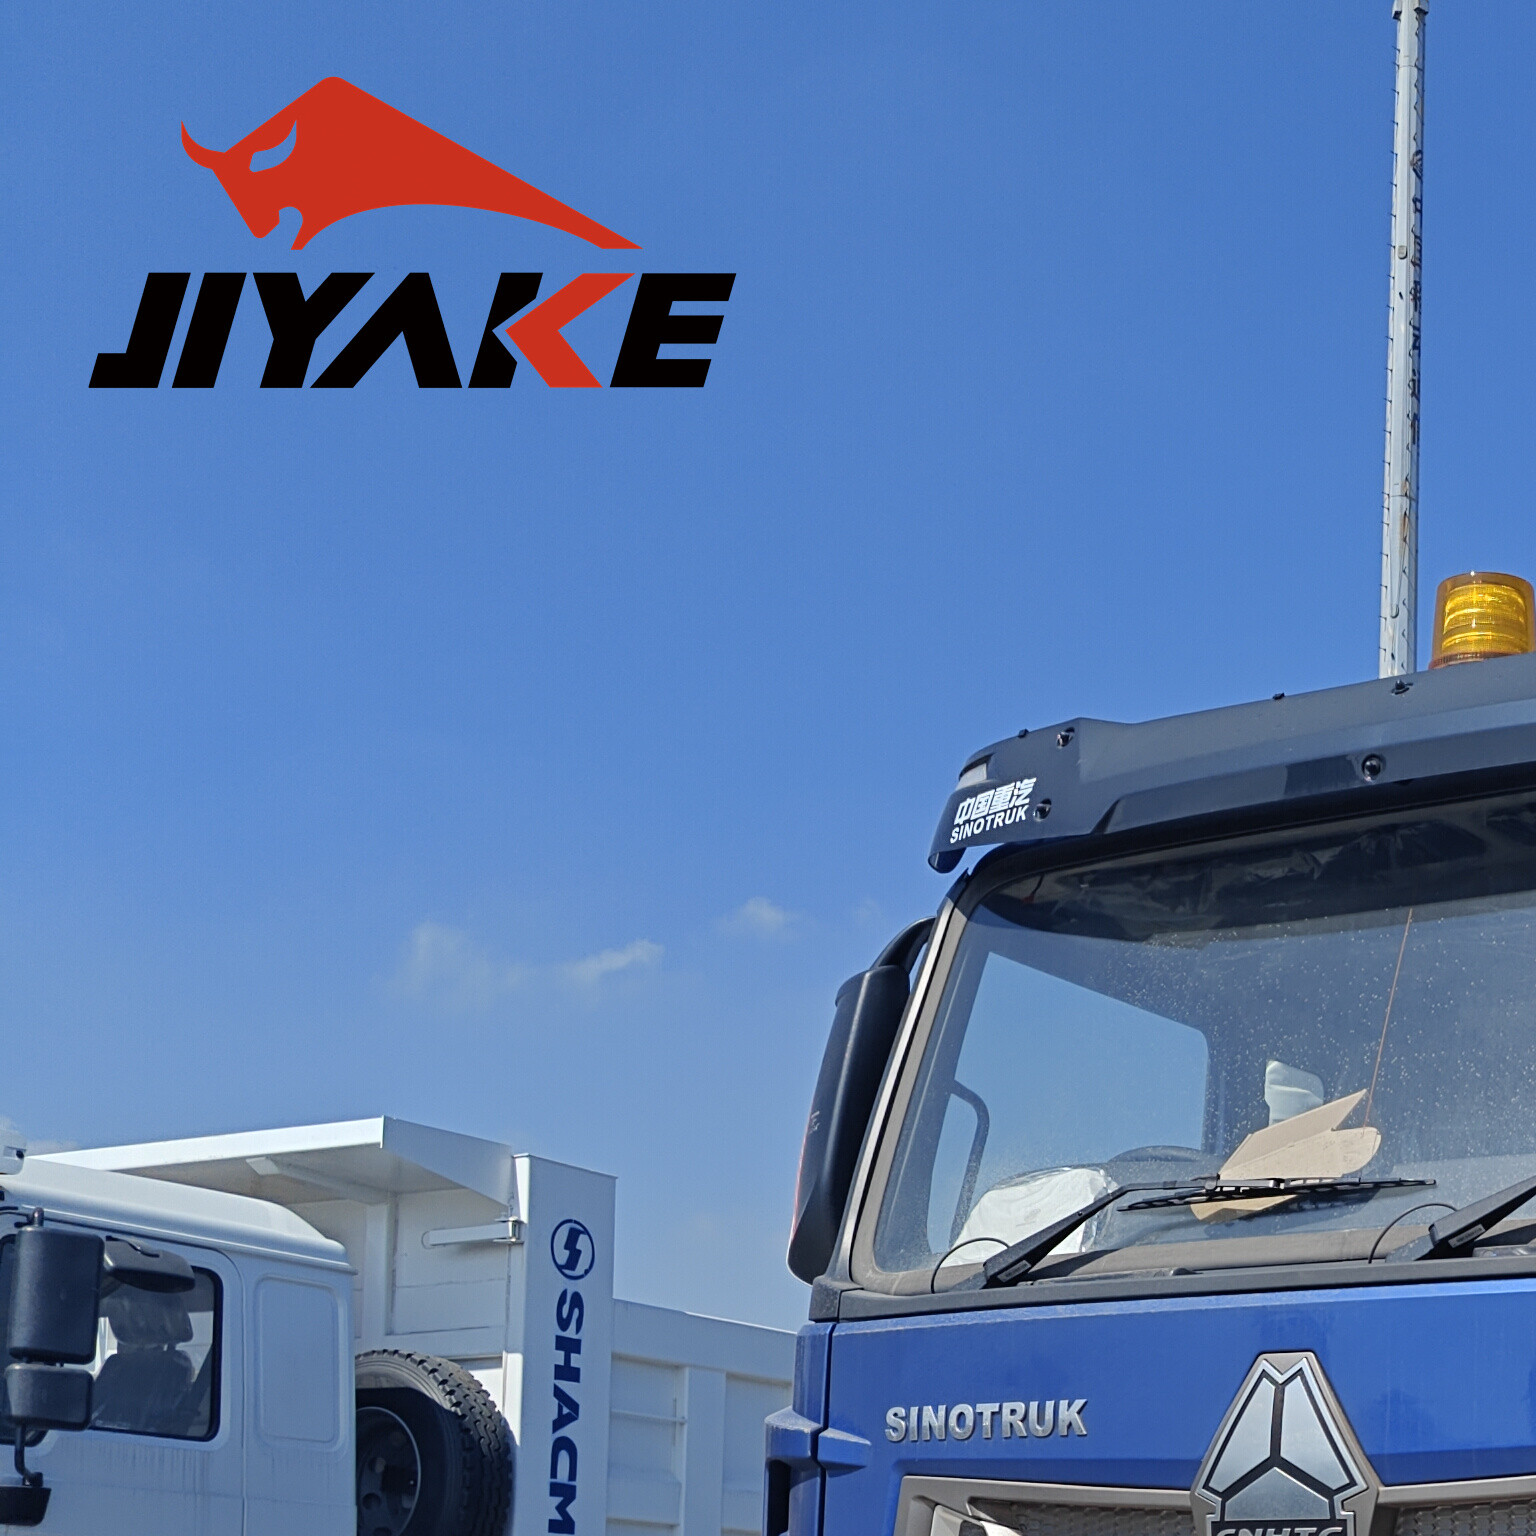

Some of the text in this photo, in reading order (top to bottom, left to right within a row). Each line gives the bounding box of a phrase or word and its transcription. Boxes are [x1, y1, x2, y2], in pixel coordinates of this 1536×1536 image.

[953, 777, 1037, 826] 中国重汽
[950, 804, 1030, 844] SINOTRUK
[885, 1399, 1088, 1443] SINOTRUK
